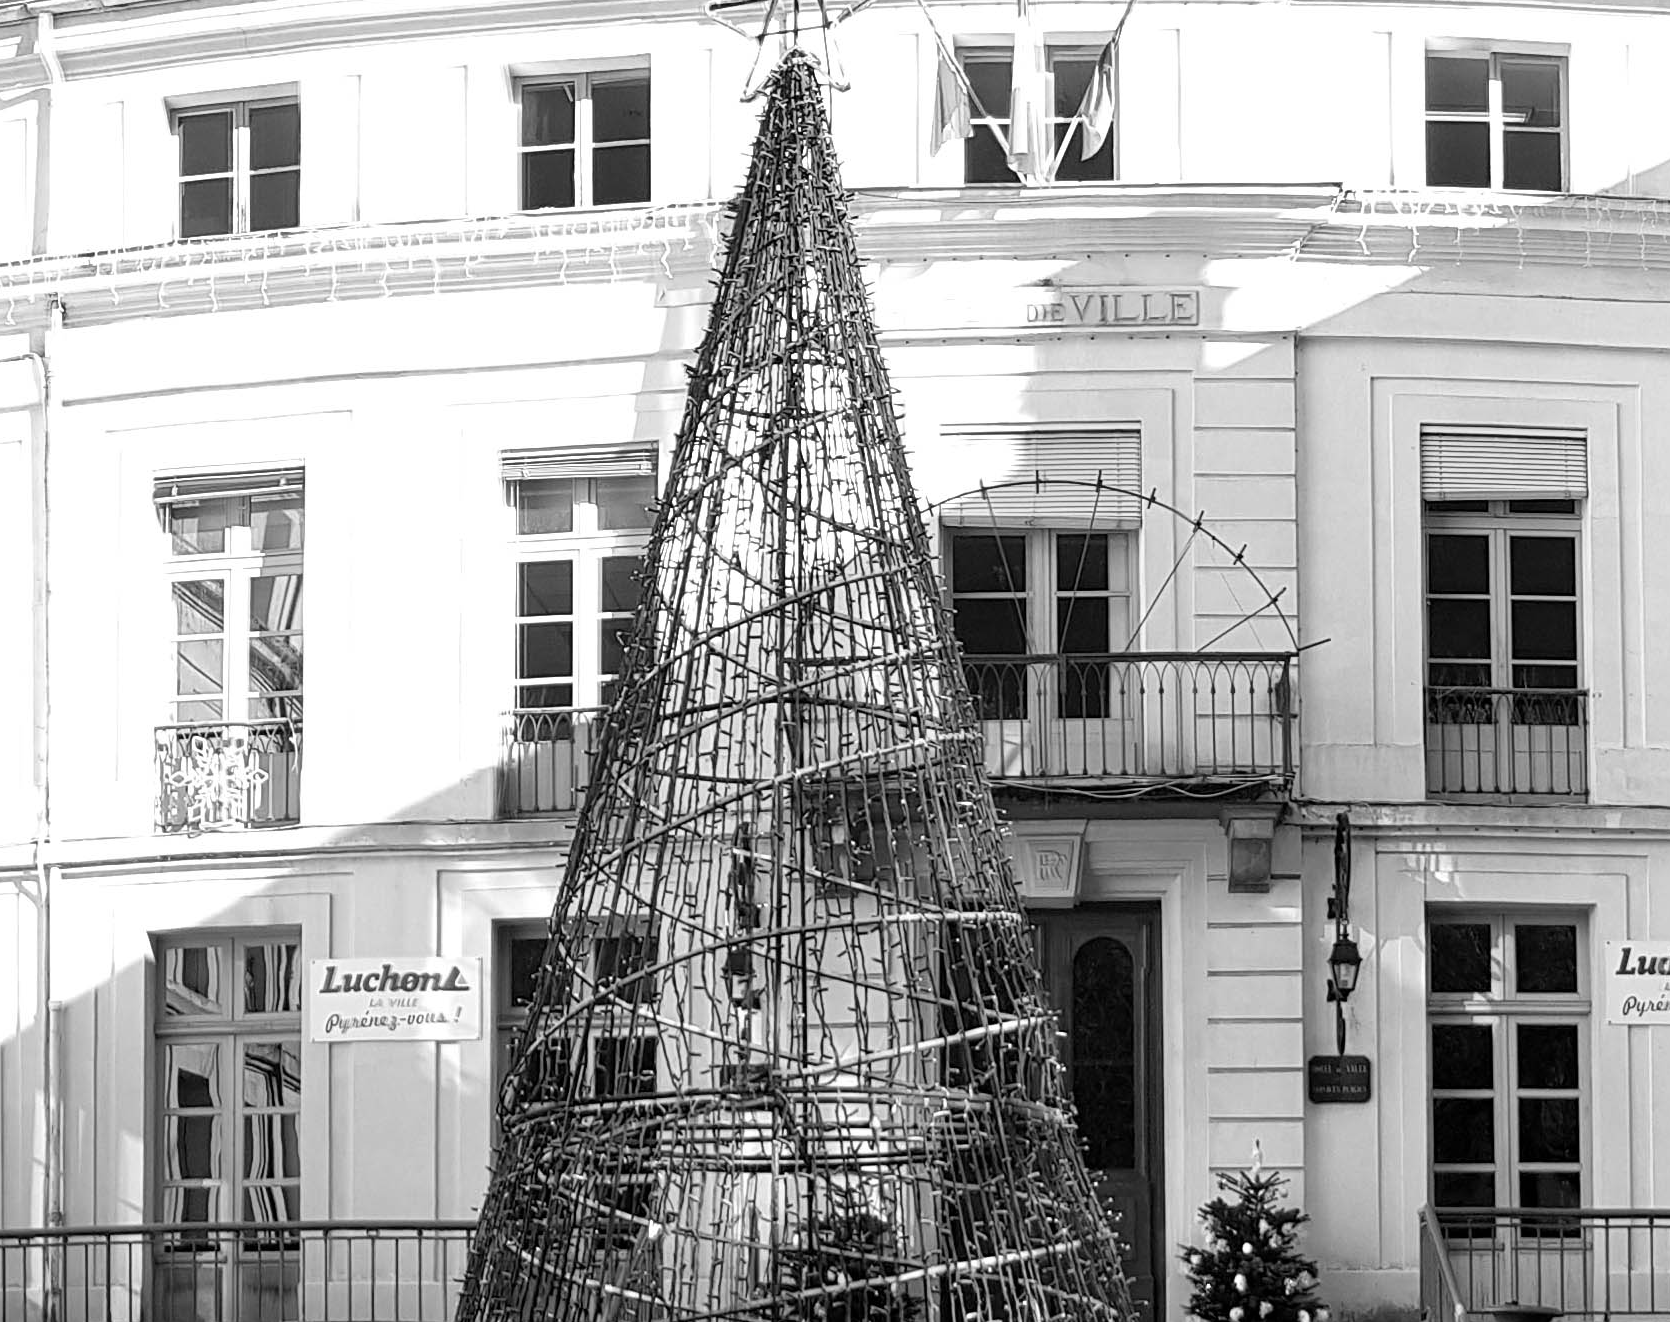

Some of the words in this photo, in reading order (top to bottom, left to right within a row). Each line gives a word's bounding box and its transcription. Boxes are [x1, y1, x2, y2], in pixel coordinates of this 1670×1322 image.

[1069, 293, 1194, 323] VILLE
[318, 963, 443, 994] Luchon
[388, 997, 420, 1008] VILLE
